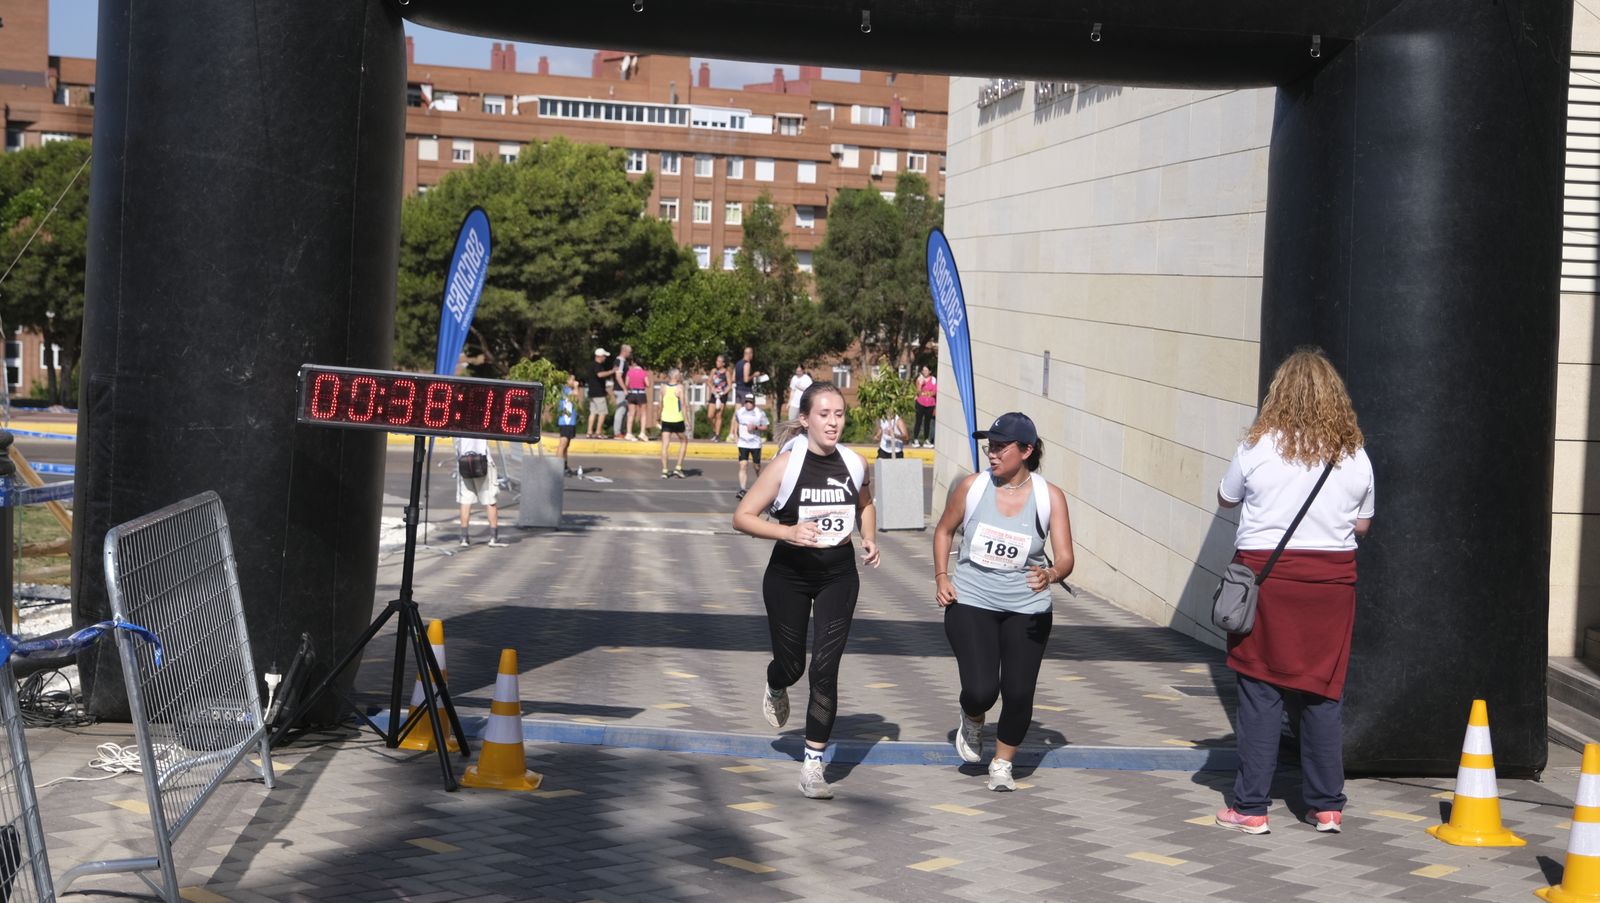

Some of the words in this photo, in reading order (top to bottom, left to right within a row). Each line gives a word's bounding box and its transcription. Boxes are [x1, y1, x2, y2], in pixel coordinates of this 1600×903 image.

[311, 374, 529, 434] 00:38:16
[800, 488, 846, 503] PUMA
[815, 518, 845, 532] 93
[984, 540, 1019, 559] 189
